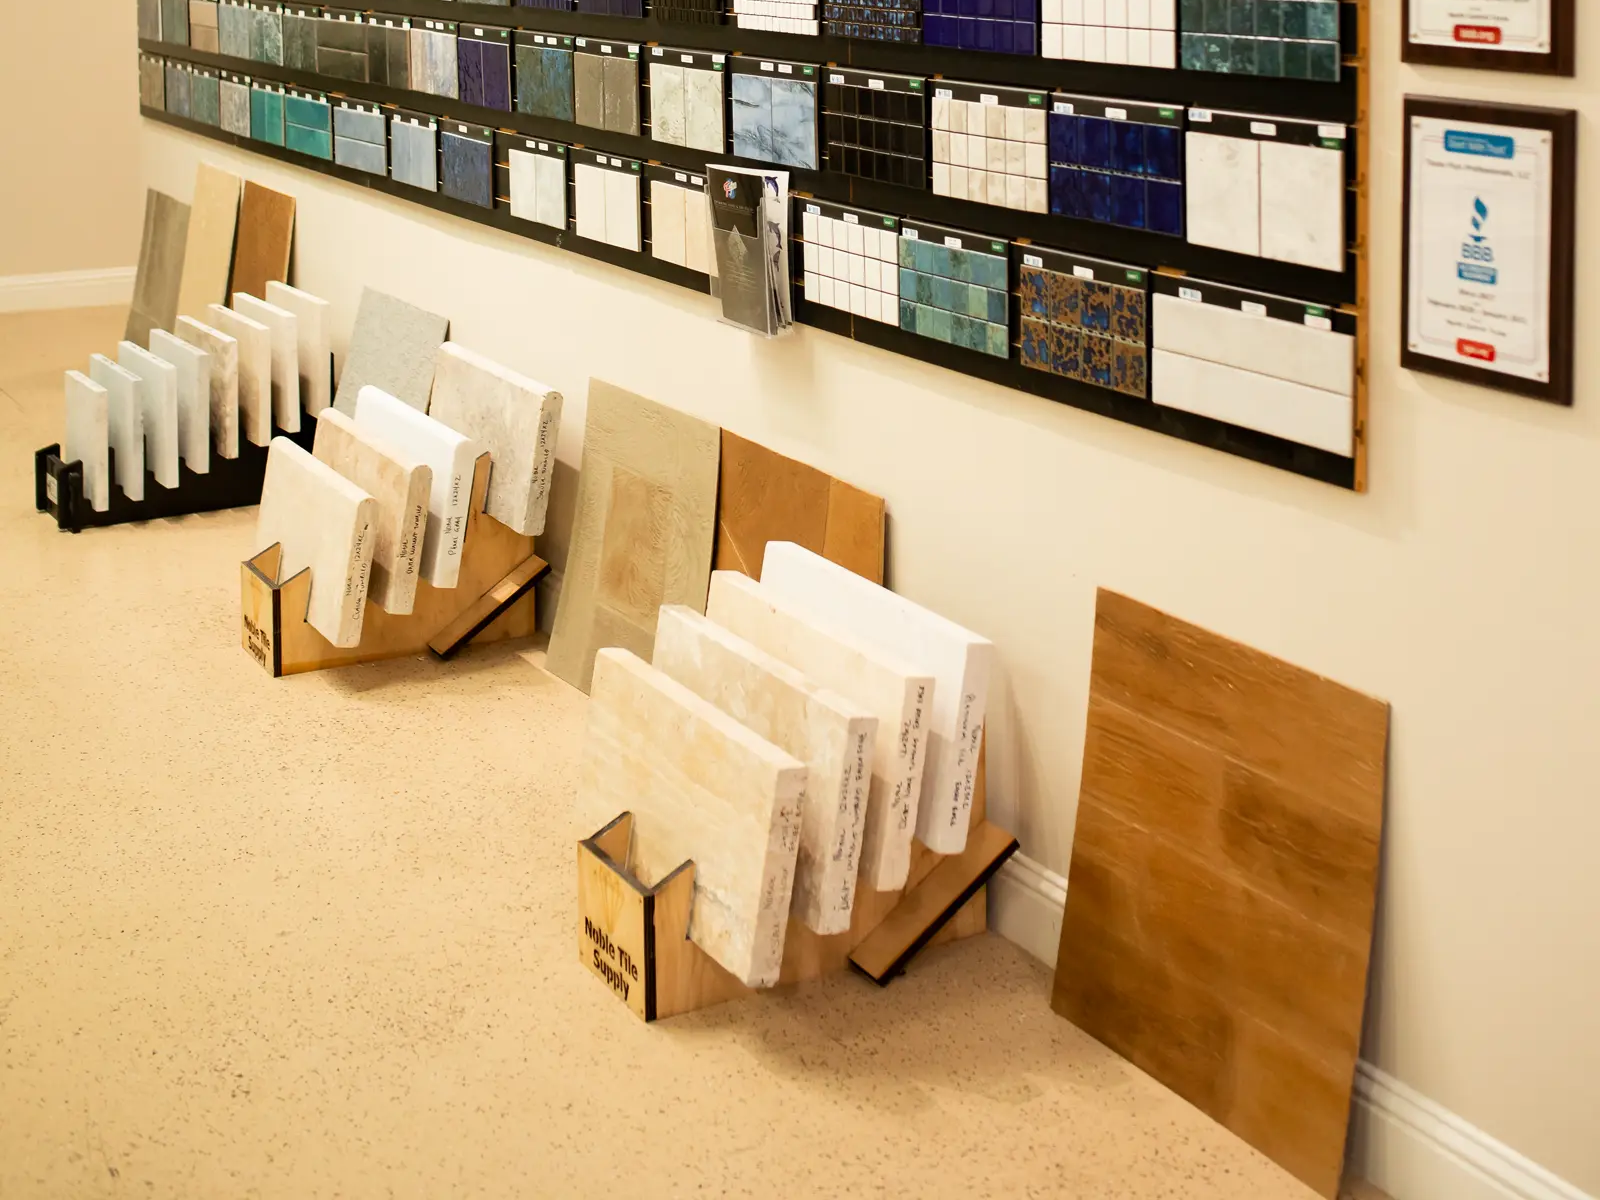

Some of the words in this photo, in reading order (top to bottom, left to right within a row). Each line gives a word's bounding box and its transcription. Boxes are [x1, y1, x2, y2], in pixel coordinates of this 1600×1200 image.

[584, 915, 616, 960] Noble
[617, 946, 639, 982] Tile
[593, 948, 630, 1002] Supply
